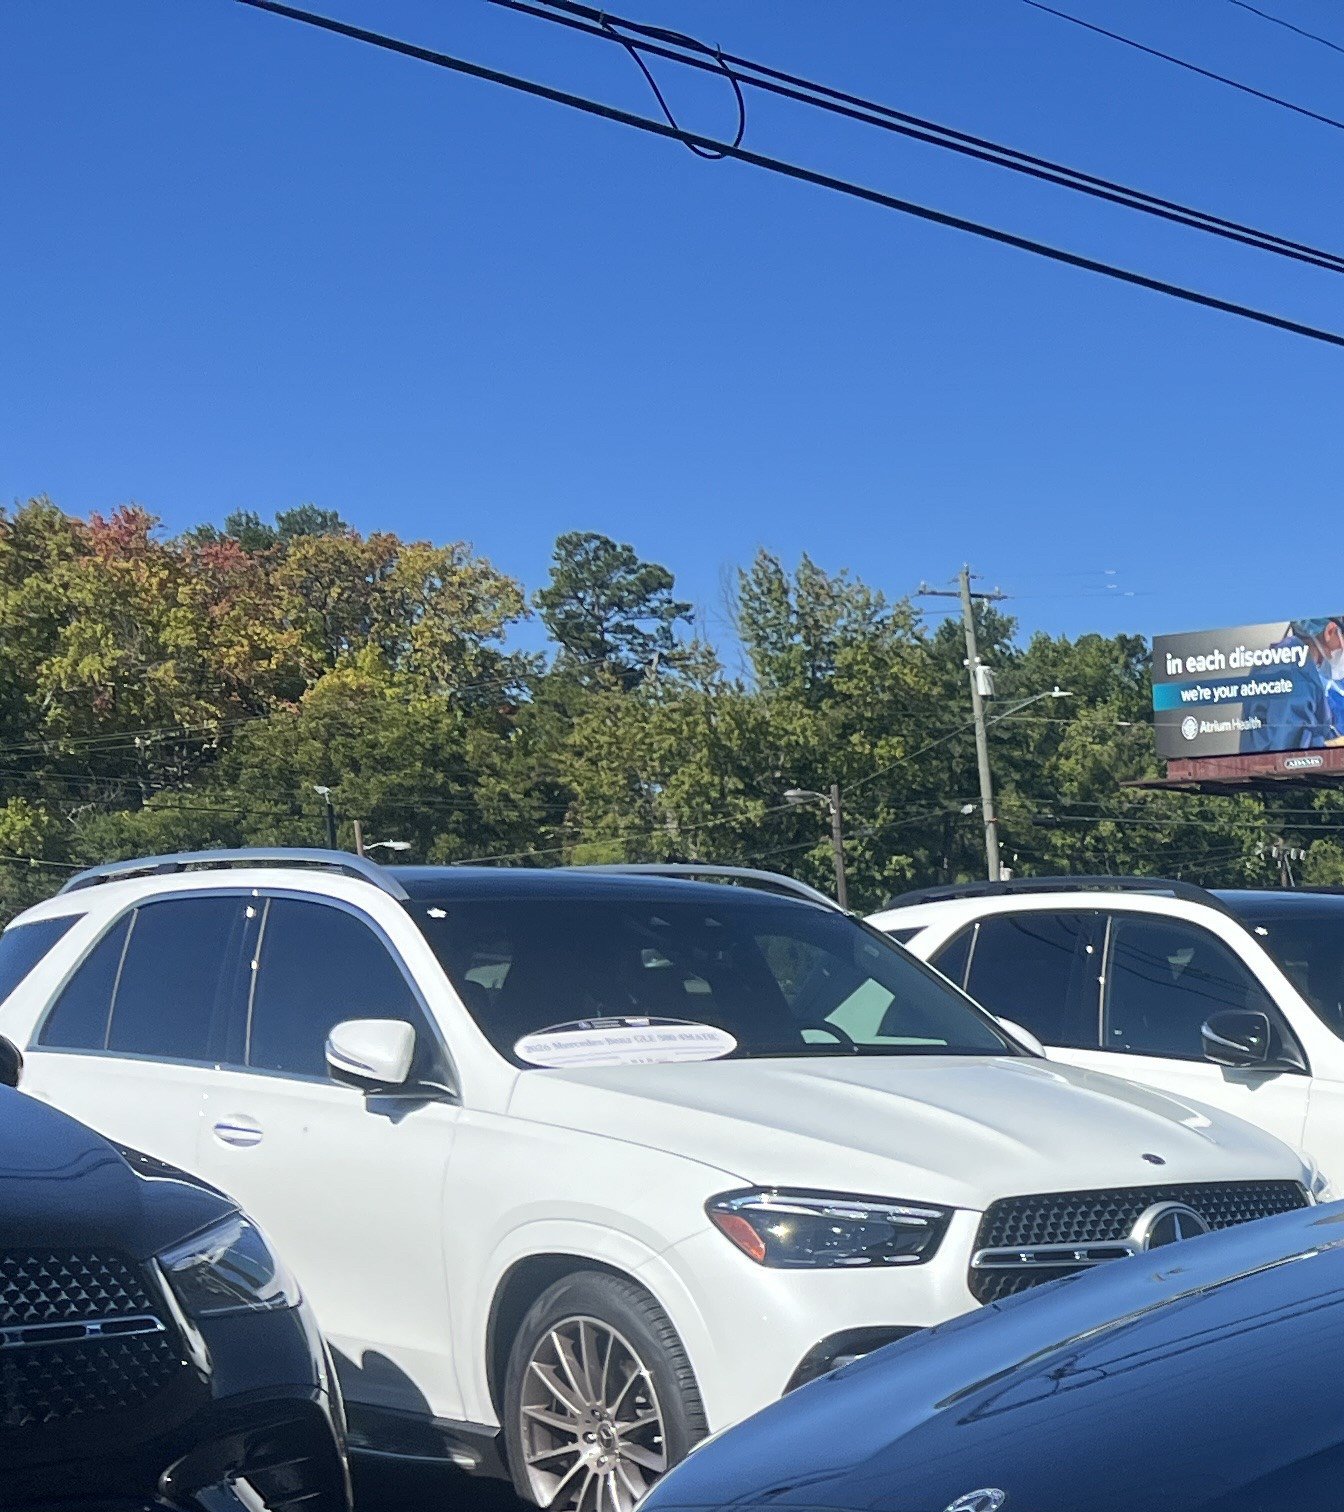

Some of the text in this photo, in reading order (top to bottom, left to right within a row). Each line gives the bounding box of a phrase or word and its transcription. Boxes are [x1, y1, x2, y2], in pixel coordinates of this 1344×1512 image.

[1166, 644, 1309, 675] in each discovery
[1181, 679, 1293, 702] we're your advocate
[1200, 716, 1262, 733] Atrium Health
